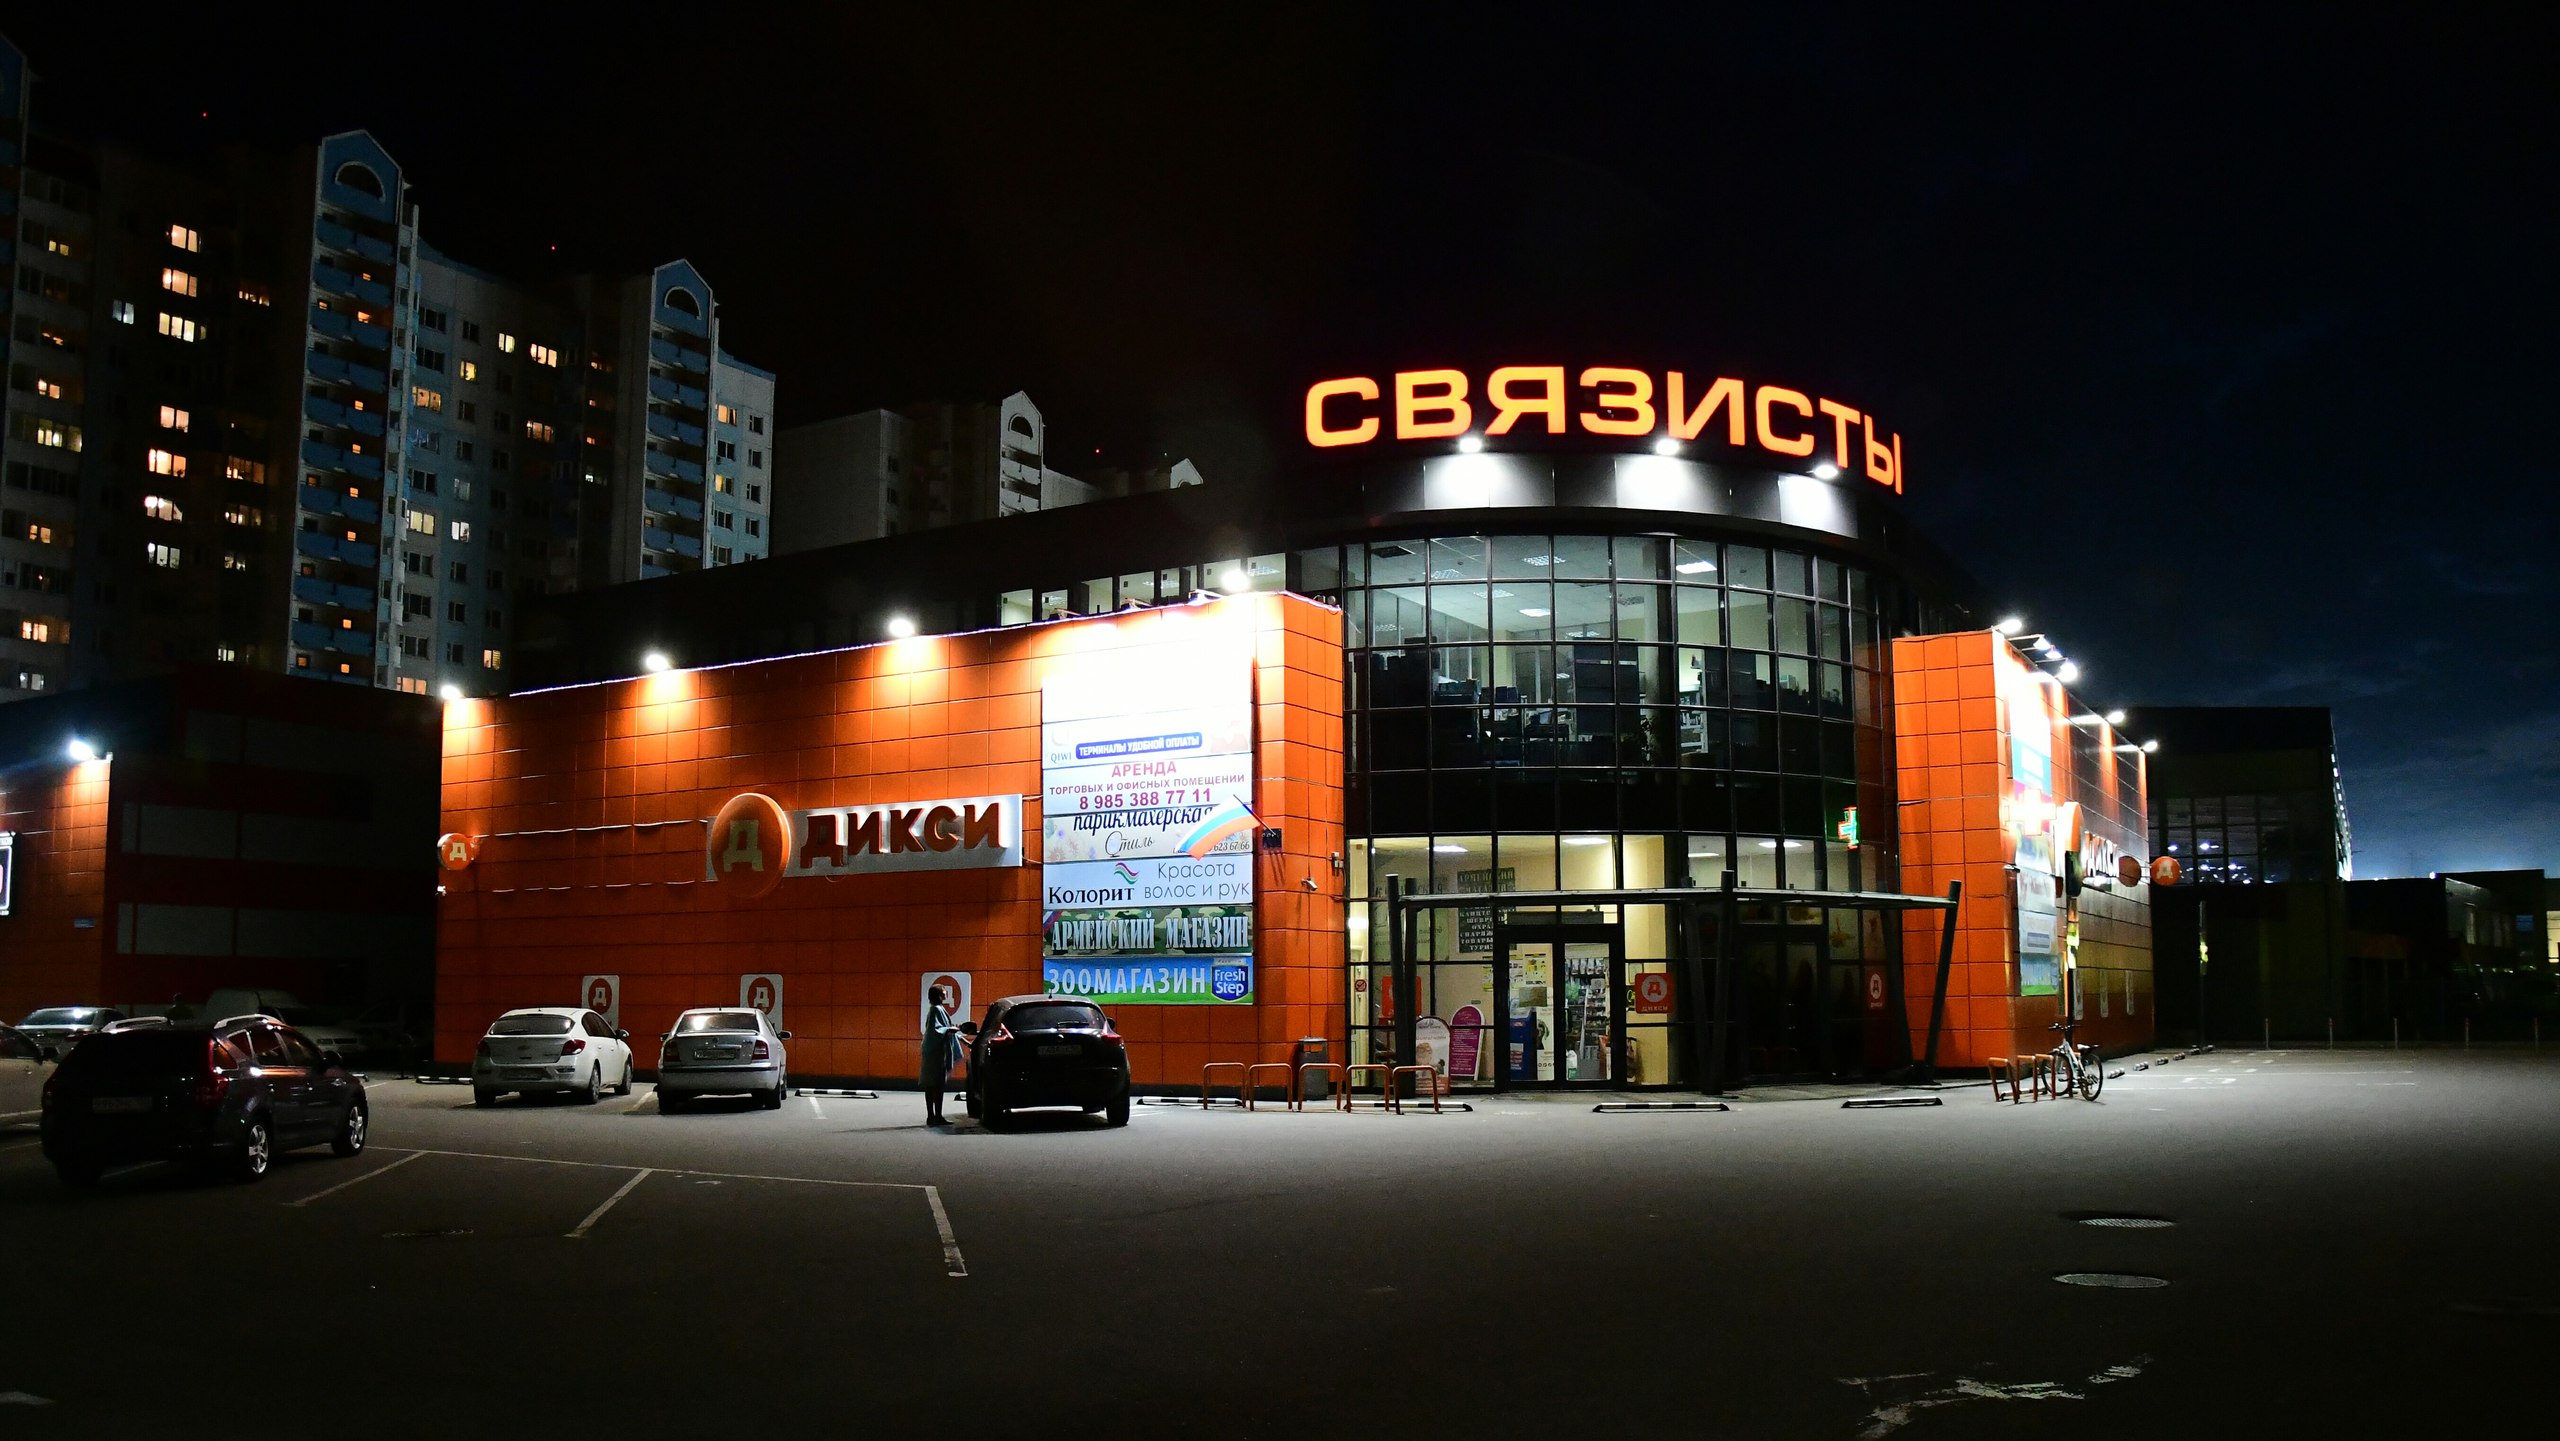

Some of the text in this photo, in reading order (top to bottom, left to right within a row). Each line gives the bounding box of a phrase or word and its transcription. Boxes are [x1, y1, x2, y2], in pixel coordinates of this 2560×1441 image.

[1305, 366, 1903, 495] СВЯЗИСТЫ
[1079, 735, 1200, 757] ТЕРМИНАЛЫ УДОБНОЙ ОПЛАТЫ
[1051, 752, 1072, 763] QIWI
[1111, 761, 1177, 777] АРЕНДА
[1050, 783, 1103, 795] ТОРГОВЫХ
[1106, 783, 1114, 791] И
[1117, 779, 1170, 791] ОФИСНЫХ
[1080, 788, 1211, 810] 8 985 388 77 11
[801, 802, 1006, 868] ДИКСИ
[1214, 842, 1228, 852] 623
[1229, 841, 1239, 851] 67
[1158, 863, 1235, 882] Красота
[1048, 887, 1135, 905] Колорит
[1145, 882, 1250, 900] волос и рук
[1052, 910, 1249, 950] АРМЕЙСКИЙ МАГАЗИН
[1048, 967, 1205, 994] ЗООМАГАЗИН
[1214, 968, 1246, 982] Fresh
[1215, 981, 1245, 996] Step
